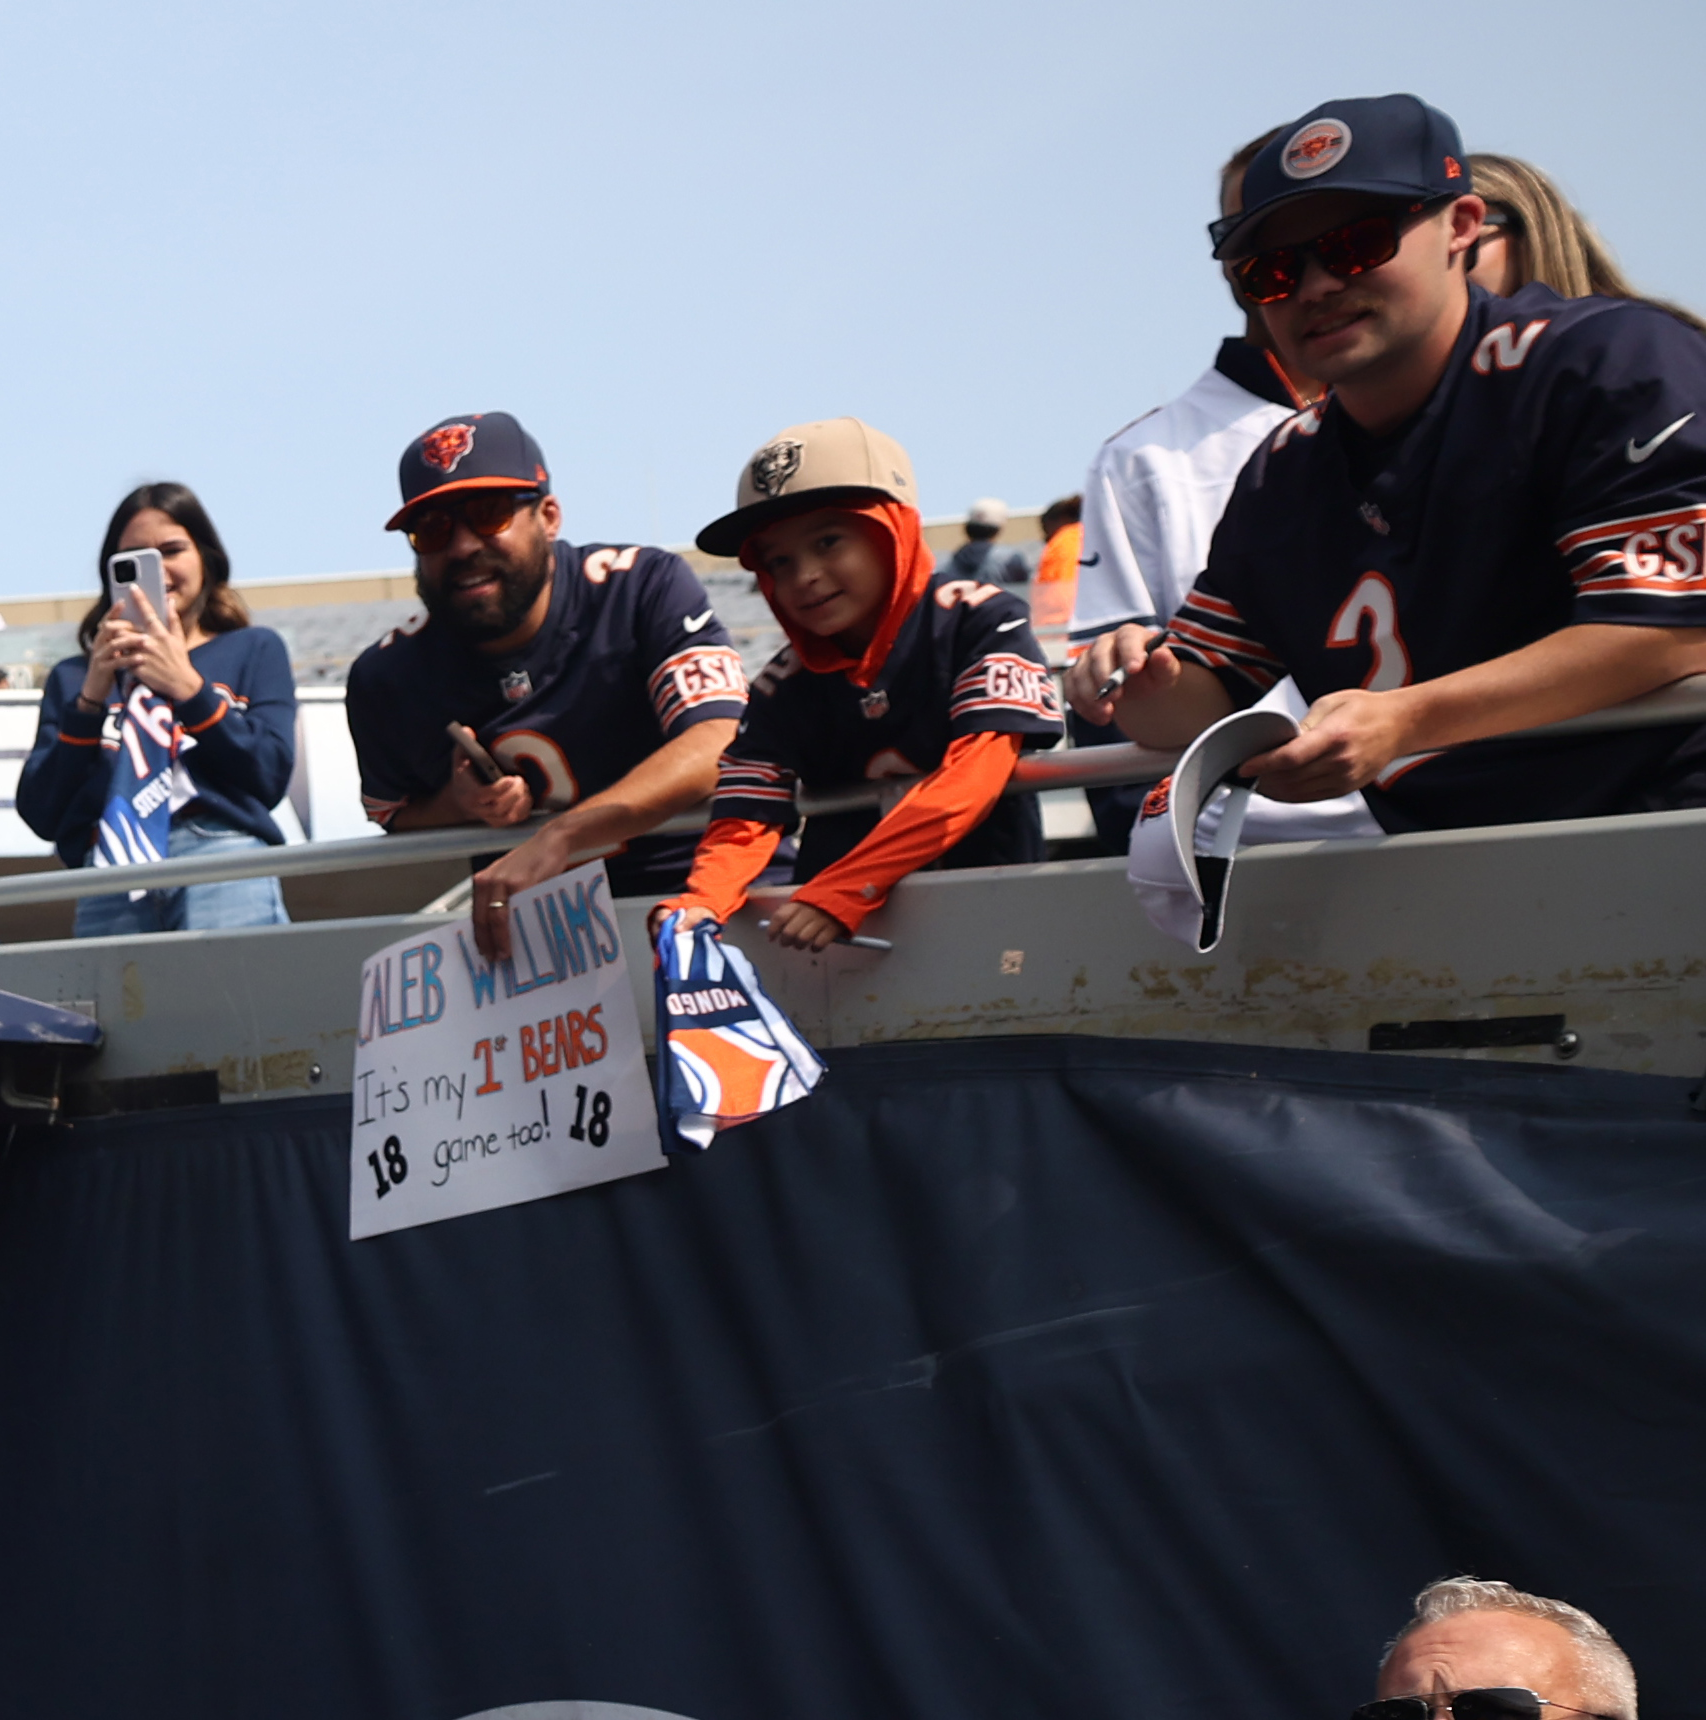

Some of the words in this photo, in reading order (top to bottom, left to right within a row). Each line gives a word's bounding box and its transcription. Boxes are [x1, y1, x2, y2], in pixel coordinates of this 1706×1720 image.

[985, 663, 1040, 702] GSH
[666, 987, 749, 1016] MONGO
[423, 1072, 467, 1121] my
[519, 1003, 610, 1084] BEARS
[366, 1133, 409, 1200] 18
[431, 1131, 502, 1188] game
[505, 1088, 552, 1151] too!
[568, 1084, 613, 1149] 18
